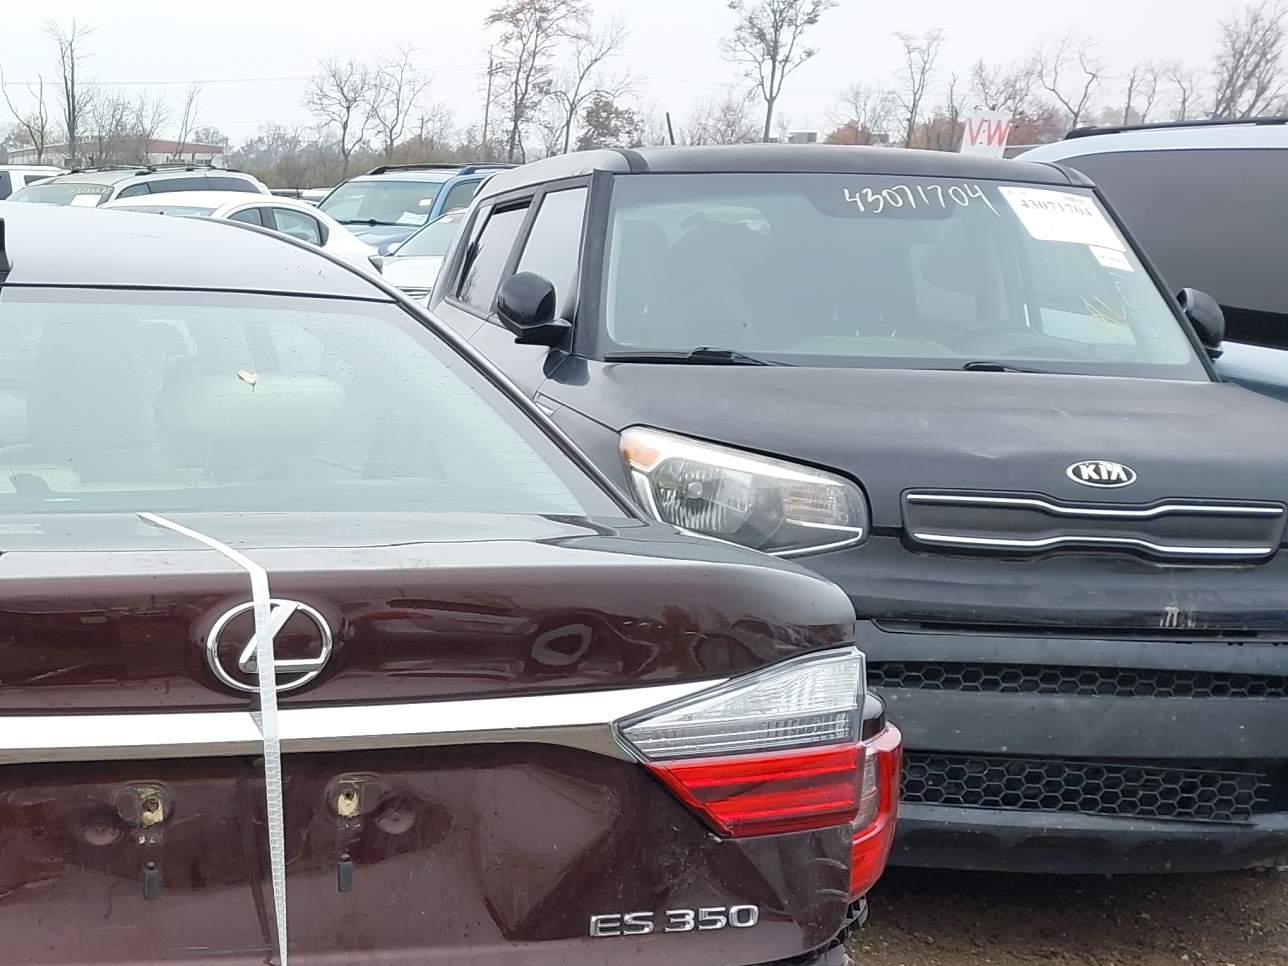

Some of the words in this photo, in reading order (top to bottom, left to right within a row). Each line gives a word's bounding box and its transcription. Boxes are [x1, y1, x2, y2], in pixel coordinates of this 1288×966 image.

[843, 183, 1001, 217] 43071704
[1079, 463, 1128, 481] KIA
[590, 913, 654, 936] ES
[664, 904, 759, 932] 350
